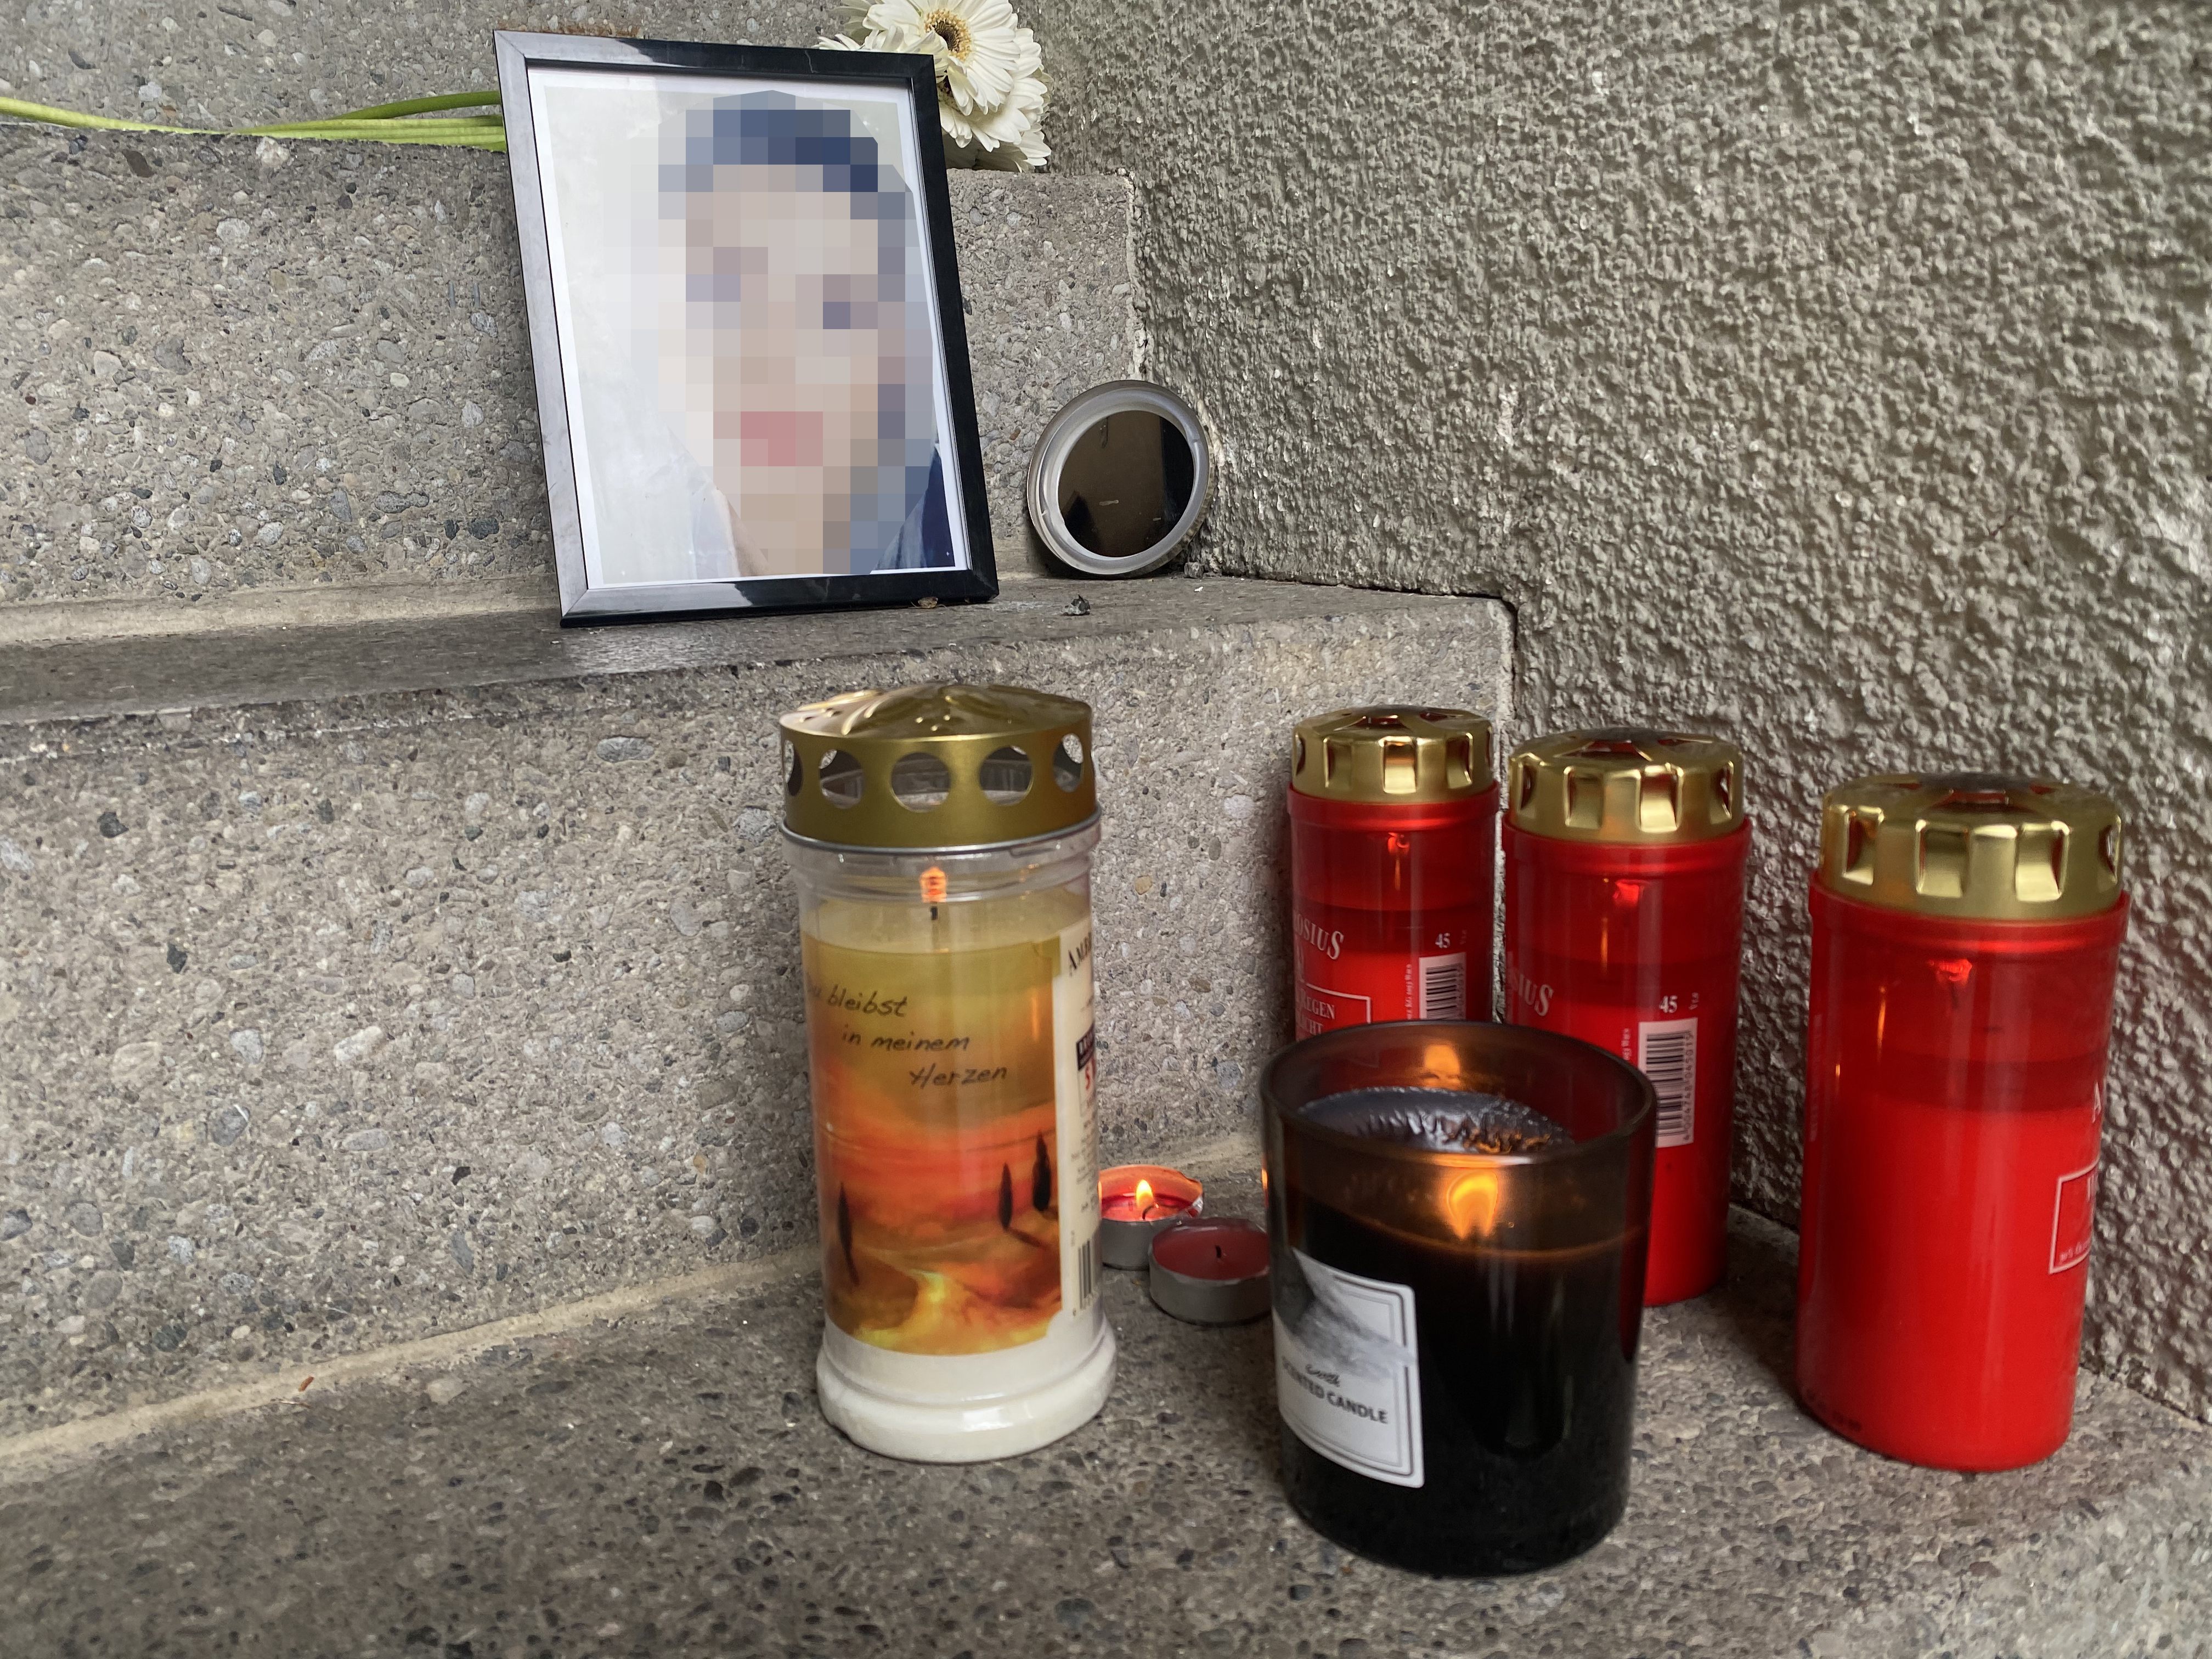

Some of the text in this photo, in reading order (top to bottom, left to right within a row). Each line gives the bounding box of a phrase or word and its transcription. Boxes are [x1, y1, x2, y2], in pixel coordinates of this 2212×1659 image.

[1294, 914, 1344, 960] OSIUS
[1435, 933, 1451, 949] 45
[827, 985, 908, 1017] bleibst
[1658, 995, 1678, 1014] 45
[842, 1023, 970, 1052] in meinem
[909, 1062, 1008, 1090] Herzen
[1326, 1390, 1389, 1425] CANDLE
